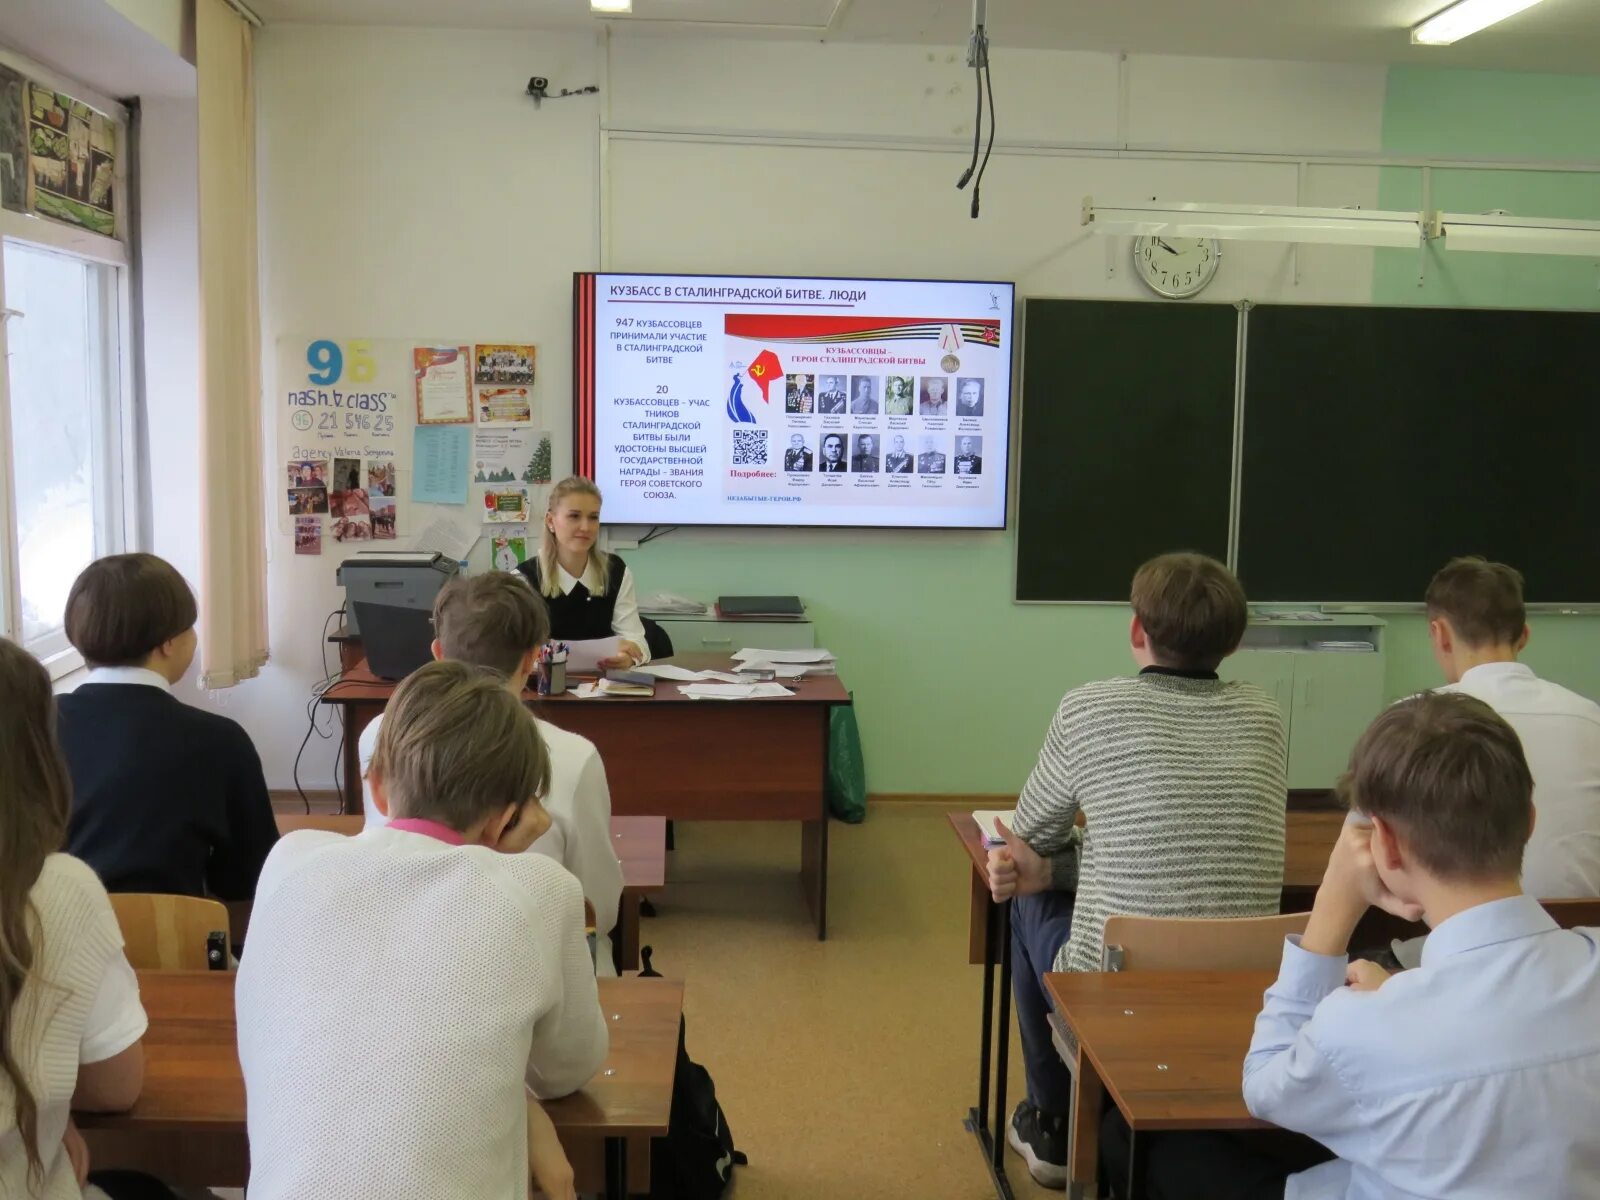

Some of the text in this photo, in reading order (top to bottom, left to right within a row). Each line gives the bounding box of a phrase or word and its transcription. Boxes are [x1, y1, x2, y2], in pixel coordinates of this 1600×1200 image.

[1144, 248, 1152, 262] 9
[1201, 248, 1209, 263] 3
[1150, 260, 1158, 275] 8
[1194, 263, 1201, 278] 4
[1161, 271, 1168, 285] 7
[1172, 274, 1180, 288] 6
[1184, 271, 1192, 286] 5
[610, 285, 867, 302] КУЗБАСС В СТАЛИНГРАДСКОЙ БИТВЕ. ЛЮДИ
[615, 318, 703, 329] 947 КУЗБАССОВЦЕВ
[610, 332, 708, 341] ПРИНИМАЛИ УЧАСТИЕ
[616, 343, 703, 353] В СТАЛИНГРАДСКОЙ
[826, 347, 887, 355] КУЗБАССОВЦЫ
[646, 356, 673, 364] БИТВЕ
[820, 356, 896, 365] СТАЛИНГРАДСКОЙ
[656, 385, 669, 394] 20
[613, 398, 680, 407] КУЗБАССОВЦЕВ
[688, 399, 710, 407] УЧАС
[645, 410, 680, 418] ТНИКОВ
[622, 421, 701, 430] СТАЛИНГРАДСКОЙ
[633, 433, 691, 442] БИТВЫ БЫЛИ
[614, 445, 707, 454] УДОСТОЕНЫ ВЫСШЕЙ
[620, 456, 703, 465] ГОСУДАРСТВЕННОЙ
[619, 468, 660, 477] НАГРАДЫ
[669, 468, 704, 477] ЗВАНИЯ
[730, 470, 777, 479] Подробнее:
[620, 480, 703, 488] ГЕРОЯ СОВЕТСКОГО
[643, 491, 677, 500] СОЮЗА.
